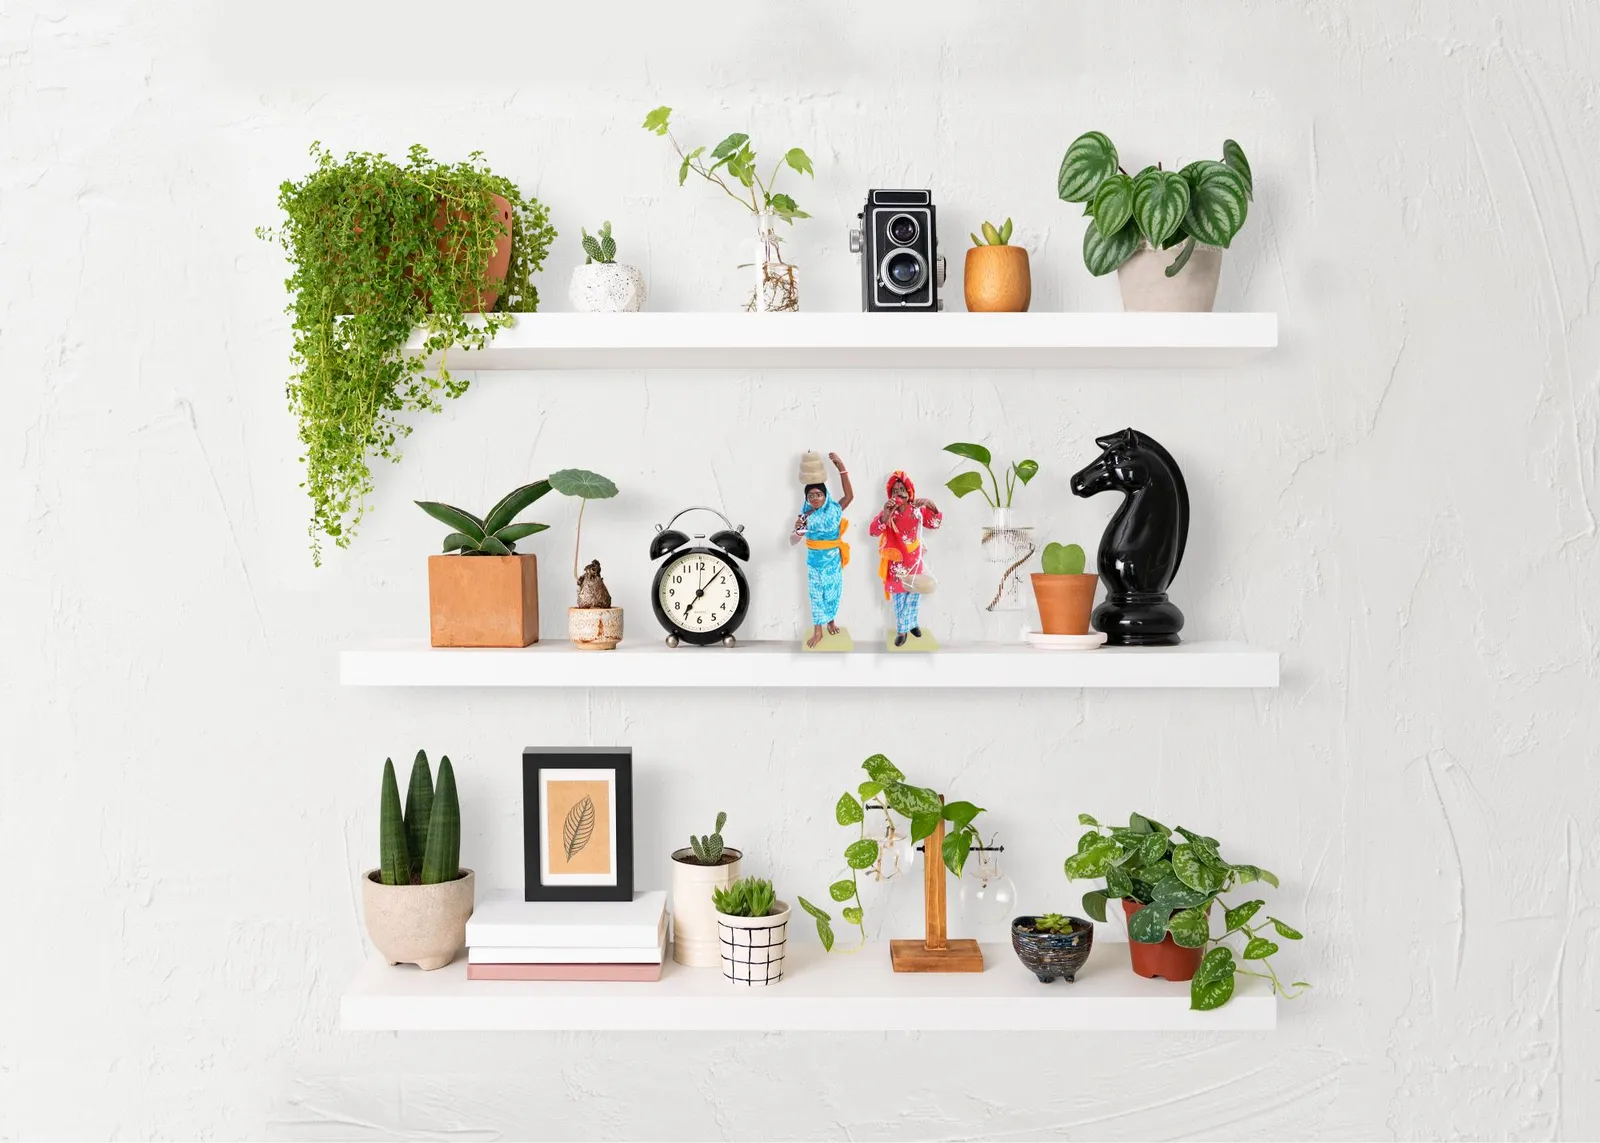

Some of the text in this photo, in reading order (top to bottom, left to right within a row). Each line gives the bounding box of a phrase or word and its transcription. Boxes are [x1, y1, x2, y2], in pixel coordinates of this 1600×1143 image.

[683, 565, 691, 573] 11
[695, 562, 705, 570] 12
[675, 602, 680, 610] 8
[697, 616, 702, 624] 6
[711, 613, 716, 621] 5
